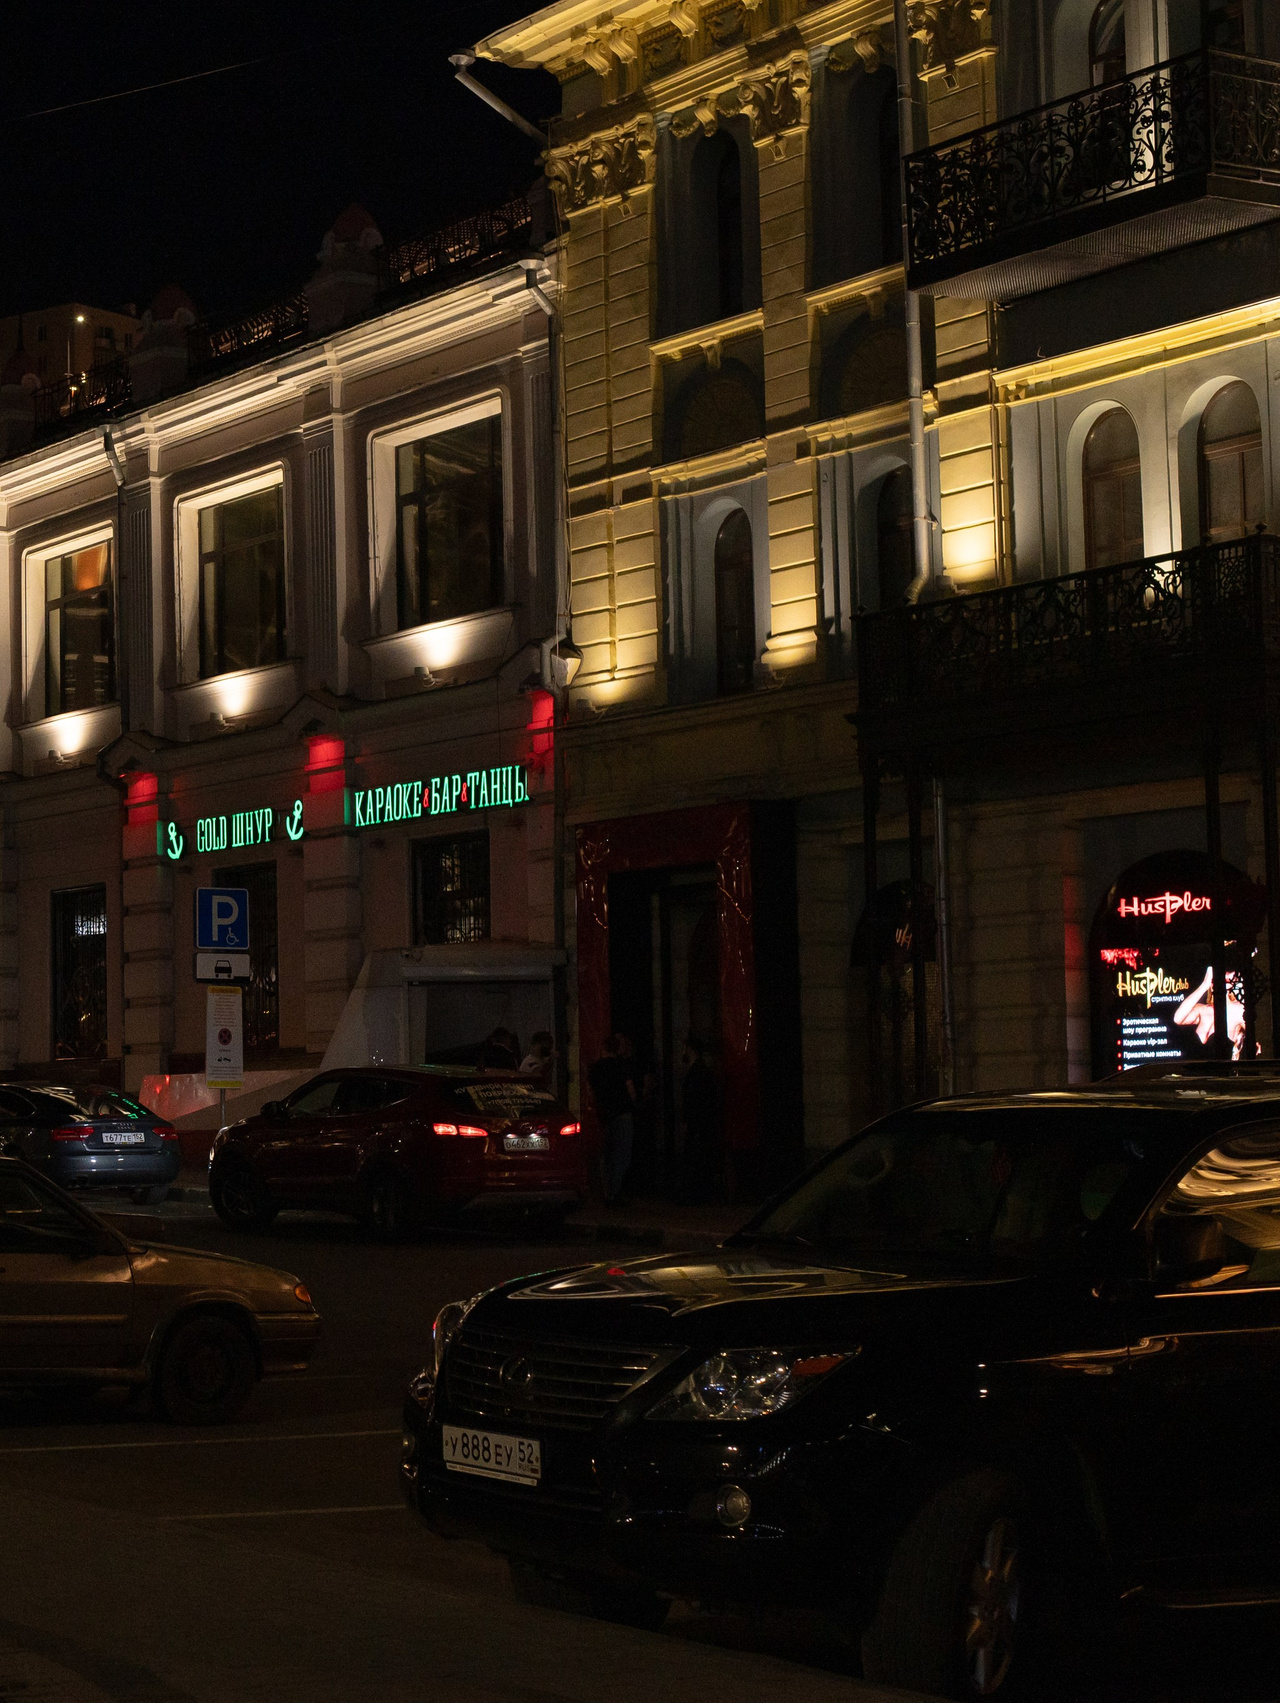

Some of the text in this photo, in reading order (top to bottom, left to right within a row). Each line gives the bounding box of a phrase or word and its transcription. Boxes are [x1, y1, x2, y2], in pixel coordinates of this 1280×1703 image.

[354, 781, 421, 827] КАРАОКЕ
[430, 775, 461, 815] БАР
[467, 765, 529, 809] ТАНЦЫ
[196, 808, 273, 853] GOLD ШНУР
[212, 895, 239, 941] P
[1117, 891, 1212, 924] Hustler
[1122, 1018, 1159, 1026] Эротическая
[1122, 1027, 1135, 1035] шоу
[1122, 1039, 1147, 1047] Караоке
[518, 1441, 534, 1464] 52
